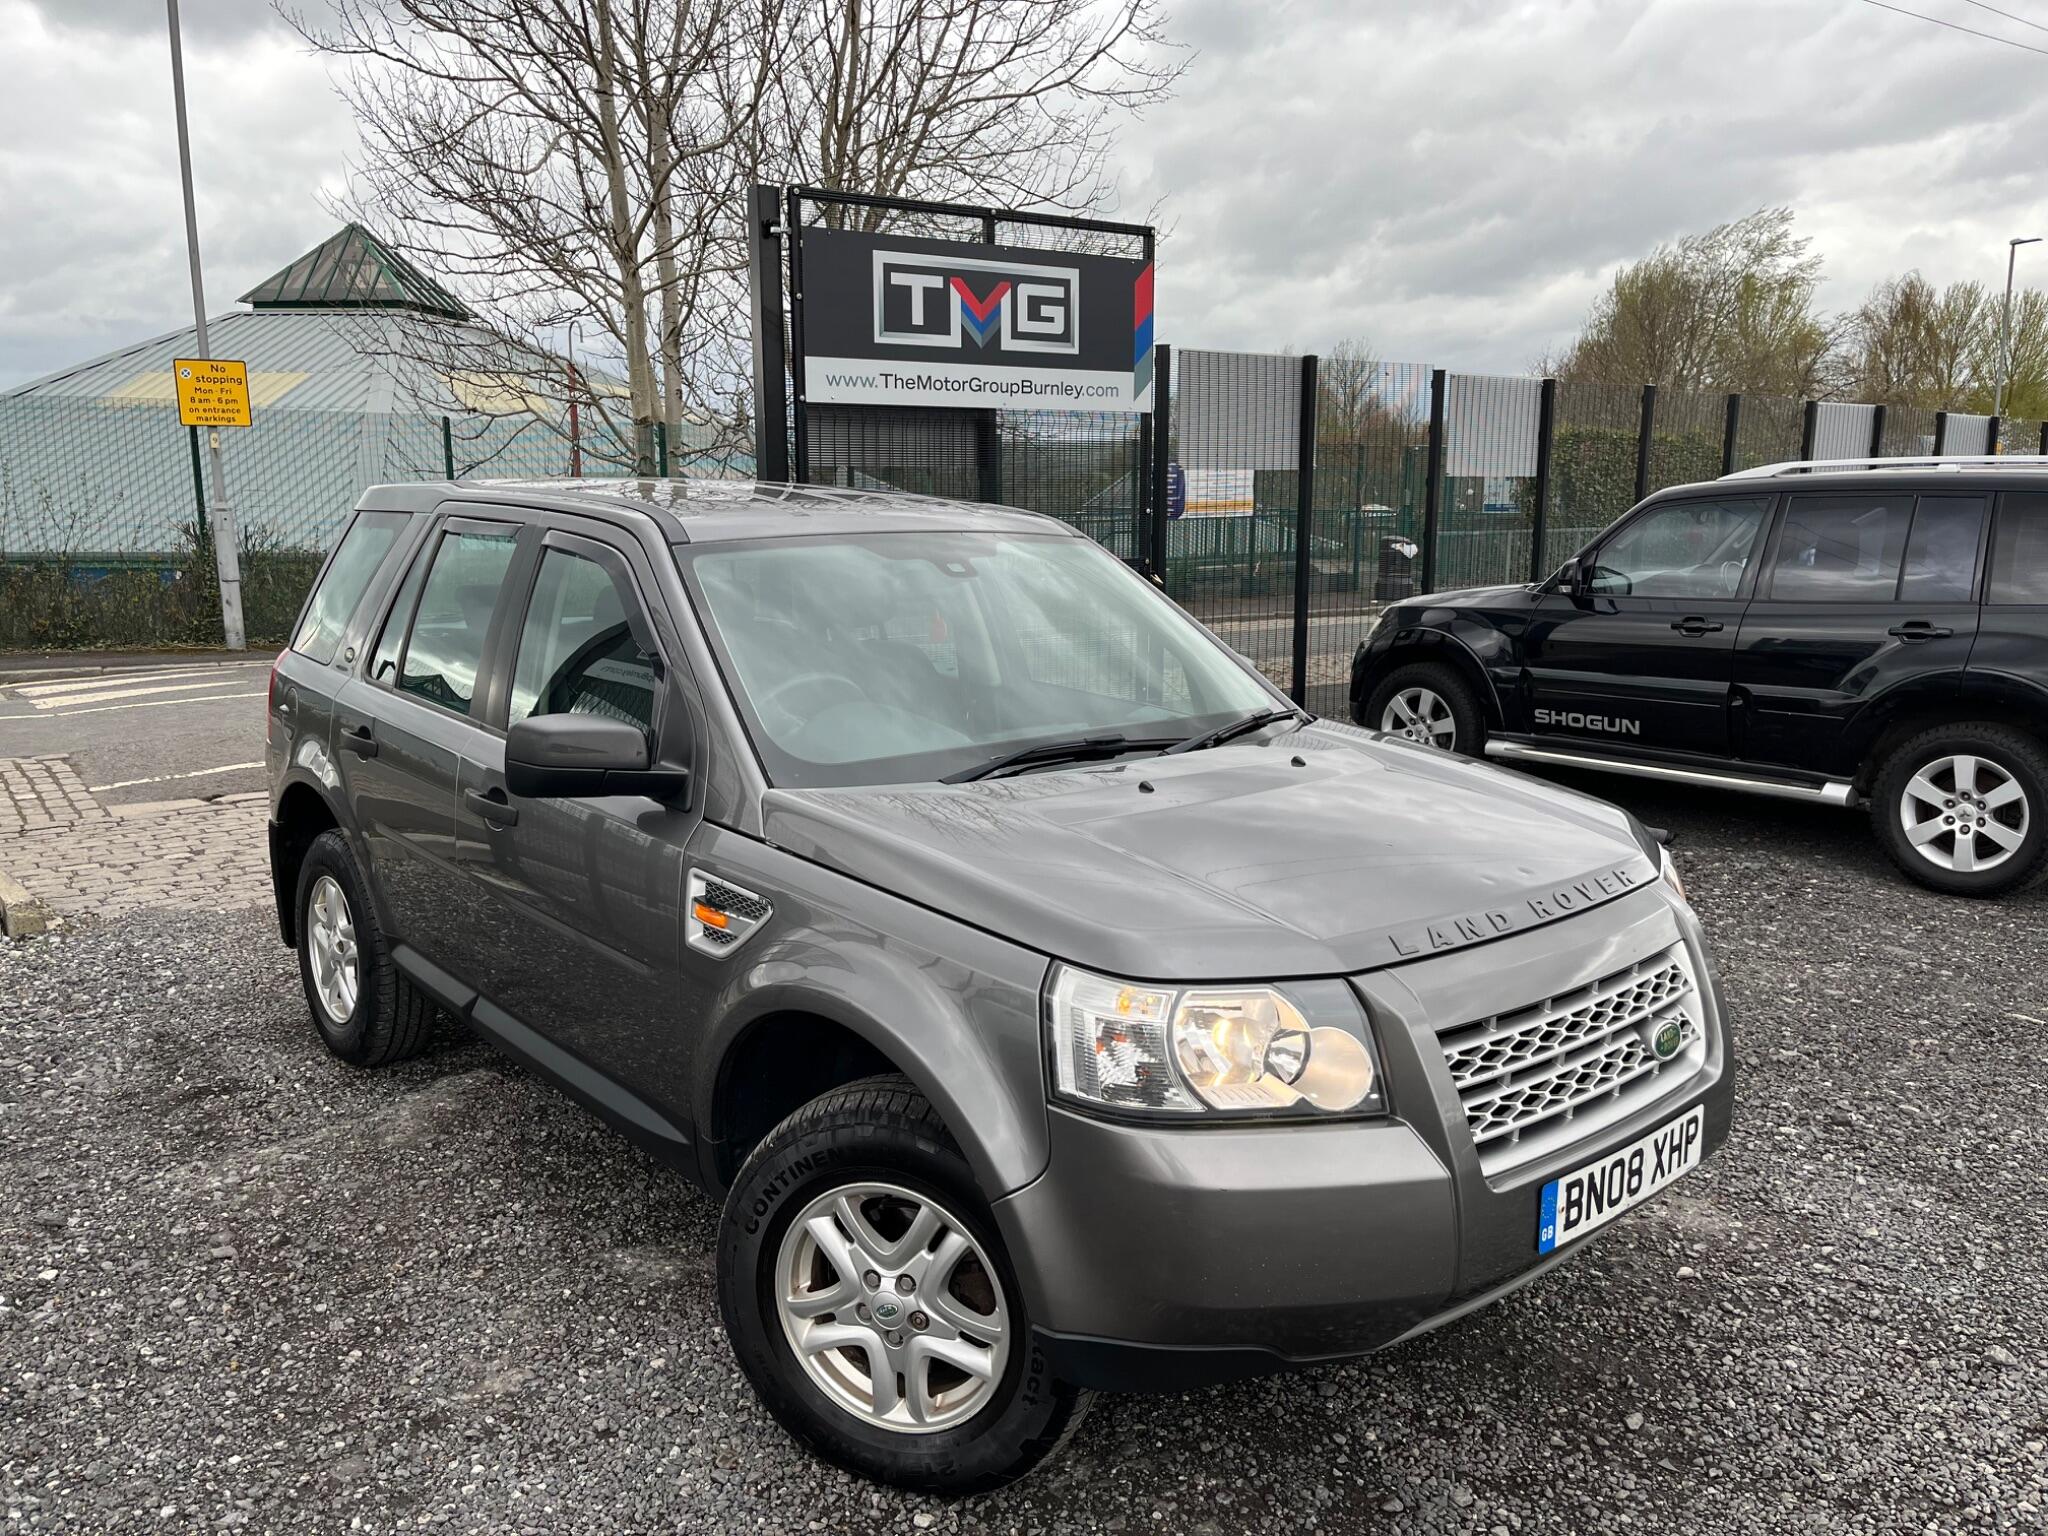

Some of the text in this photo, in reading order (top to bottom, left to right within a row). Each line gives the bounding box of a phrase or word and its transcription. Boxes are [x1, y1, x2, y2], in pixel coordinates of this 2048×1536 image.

[891, 272, 1065, 349] TMG
[195, 375, 243, 385] stopping
[210, 364, 226, 373] No
[194, 386, 213, 395] Mon
[220, 387, 232, 395] Fri
[825, 373, 1120, 398] www.TheMotorGroupBurnley.com
[196, 415, 236, 423] markings
[1534, 709, 1640, 735] SHOGUN
[1388, 870, 1637, 956] LAND ROVER
[1563, 1114, 1700, 1232] BN08 XHP
[744, 1147, 844, 1234] CONTINEN
[1541, 1225, 1554, 1242] GB
